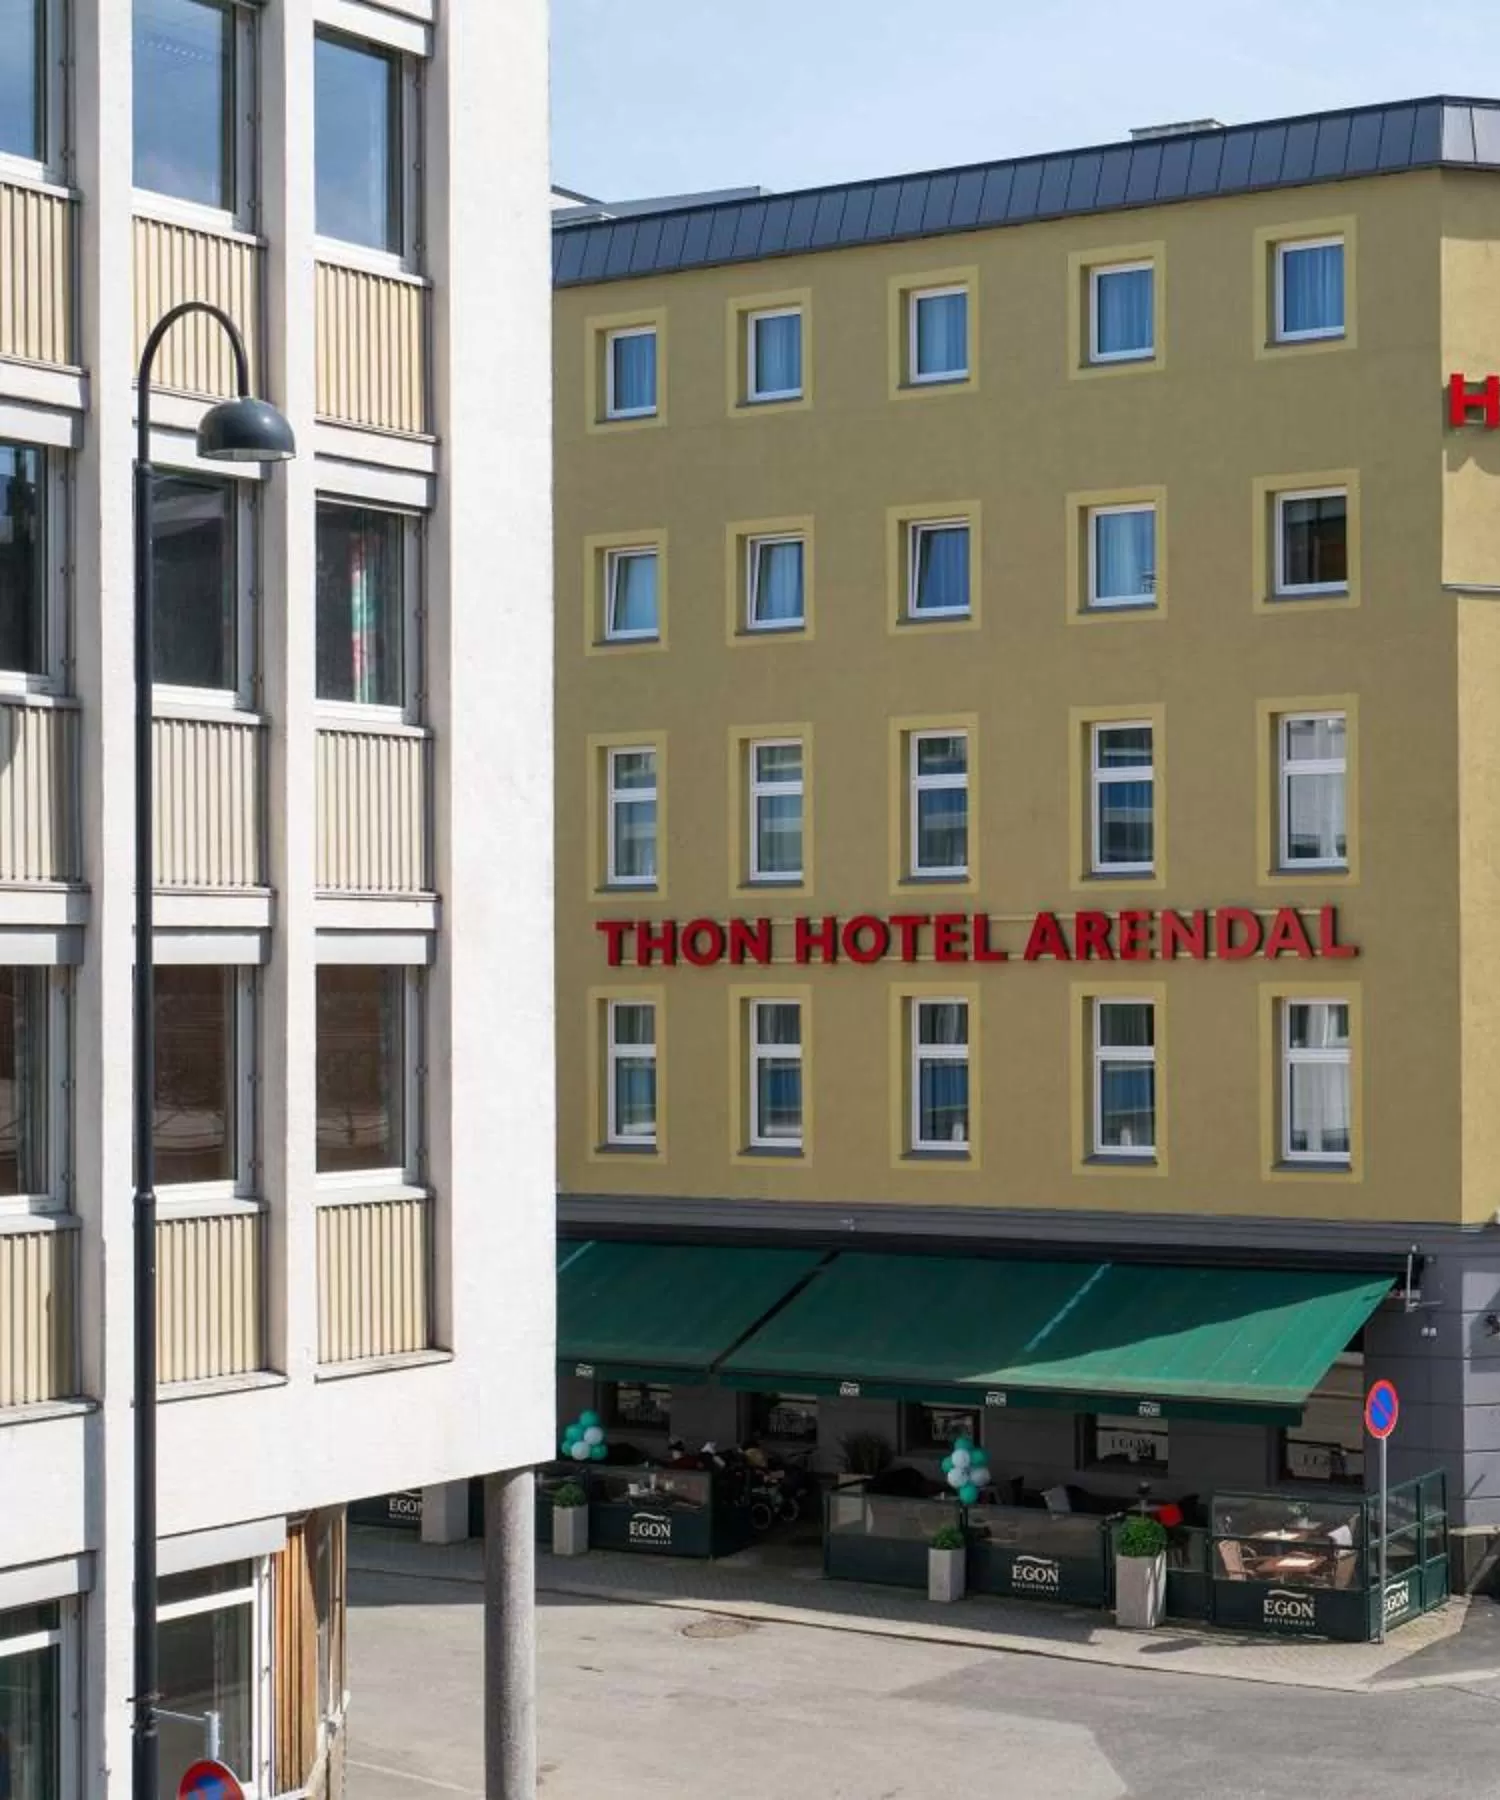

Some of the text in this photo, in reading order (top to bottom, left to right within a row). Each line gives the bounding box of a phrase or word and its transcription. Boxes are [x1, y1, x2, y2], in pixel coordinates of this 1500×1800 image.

[596, 904, 1360, 967] THON HOTEL ARENDAL
[629, 1521, 671, 1537] EGON
[1012, 1565, 1059, 1584] EGON
[1263, 1599, 1315, 1618] EGON
